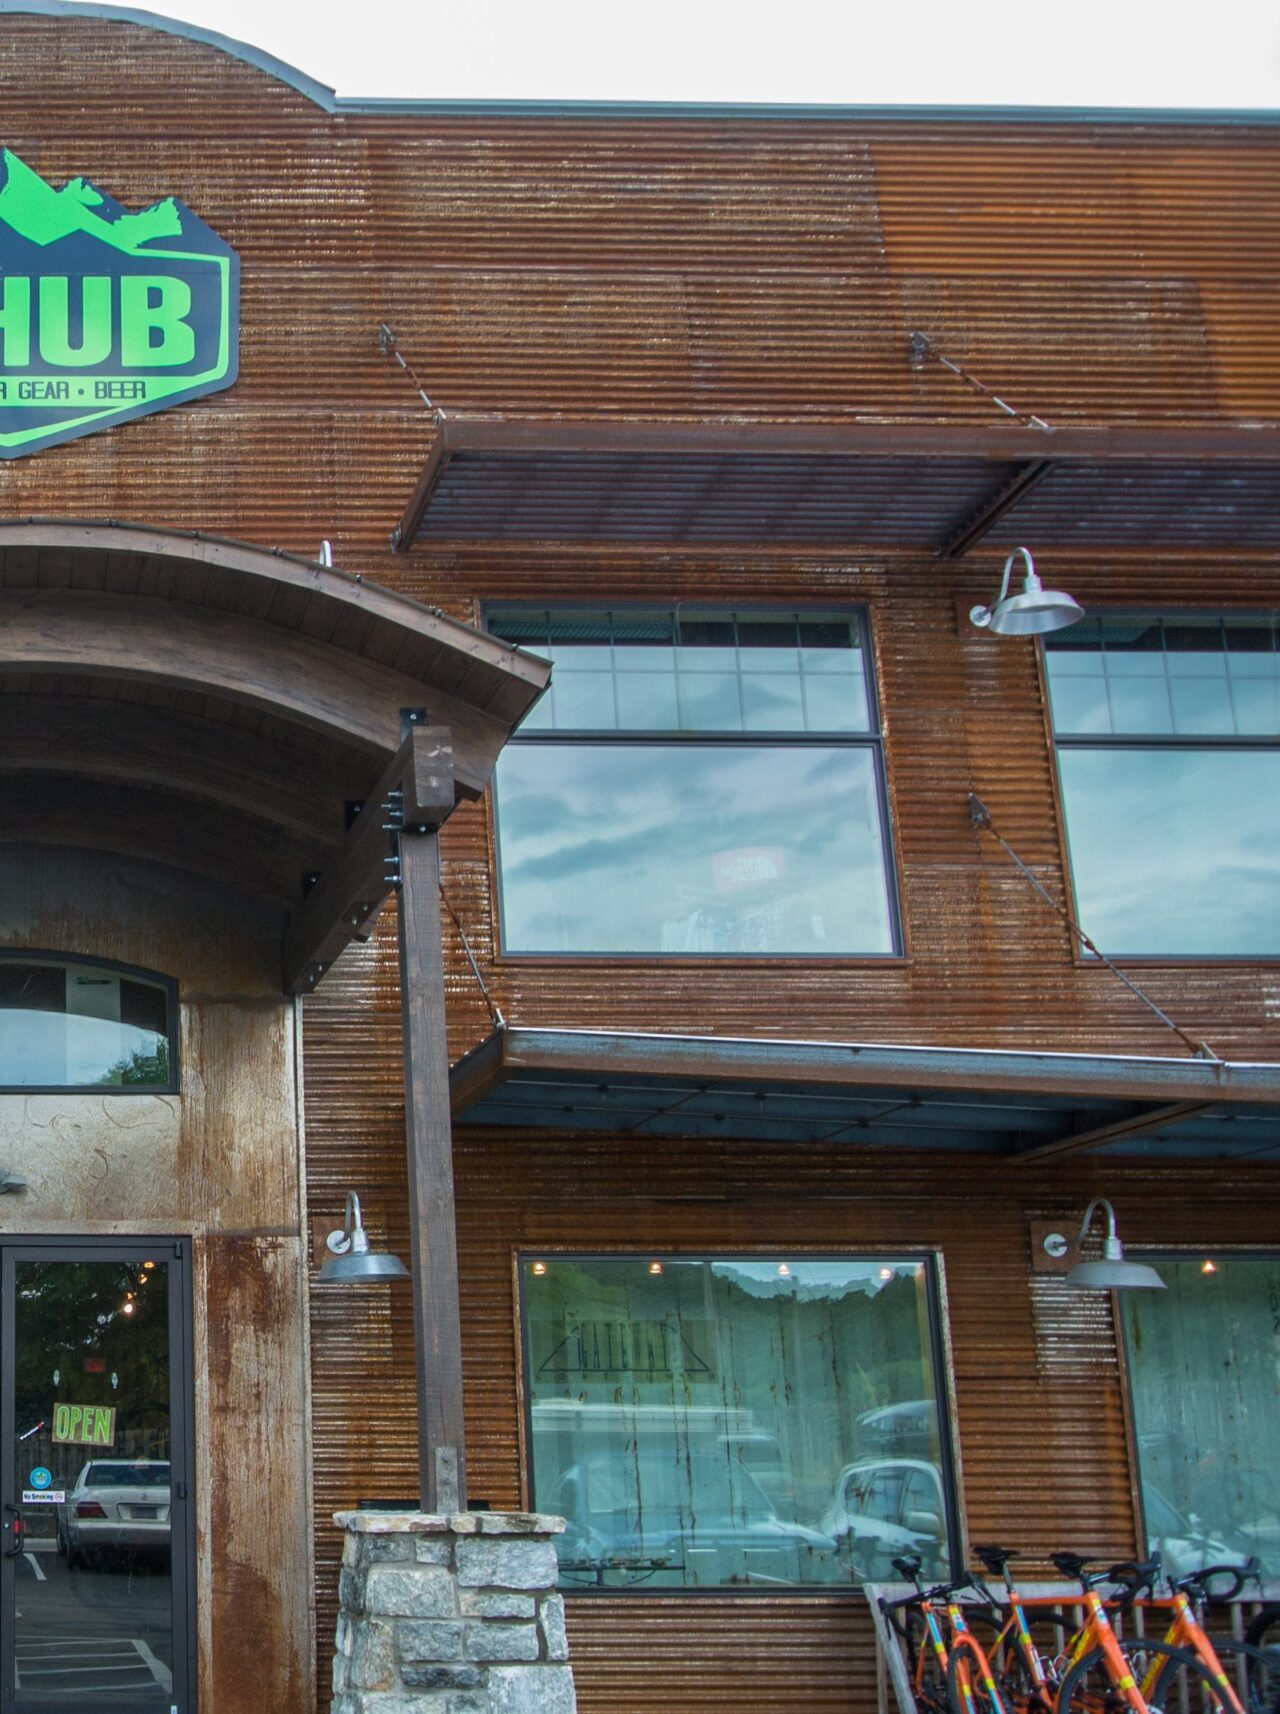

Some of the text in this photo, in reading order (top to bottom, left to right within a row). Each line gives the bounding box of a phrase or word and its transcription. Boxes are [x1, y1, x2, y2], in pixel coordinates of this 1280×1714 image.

[18, 381, 70, 400] GEAR
[95, 380, 147, 399] BEER
[56, 1406, 111, 1444] OPEN
